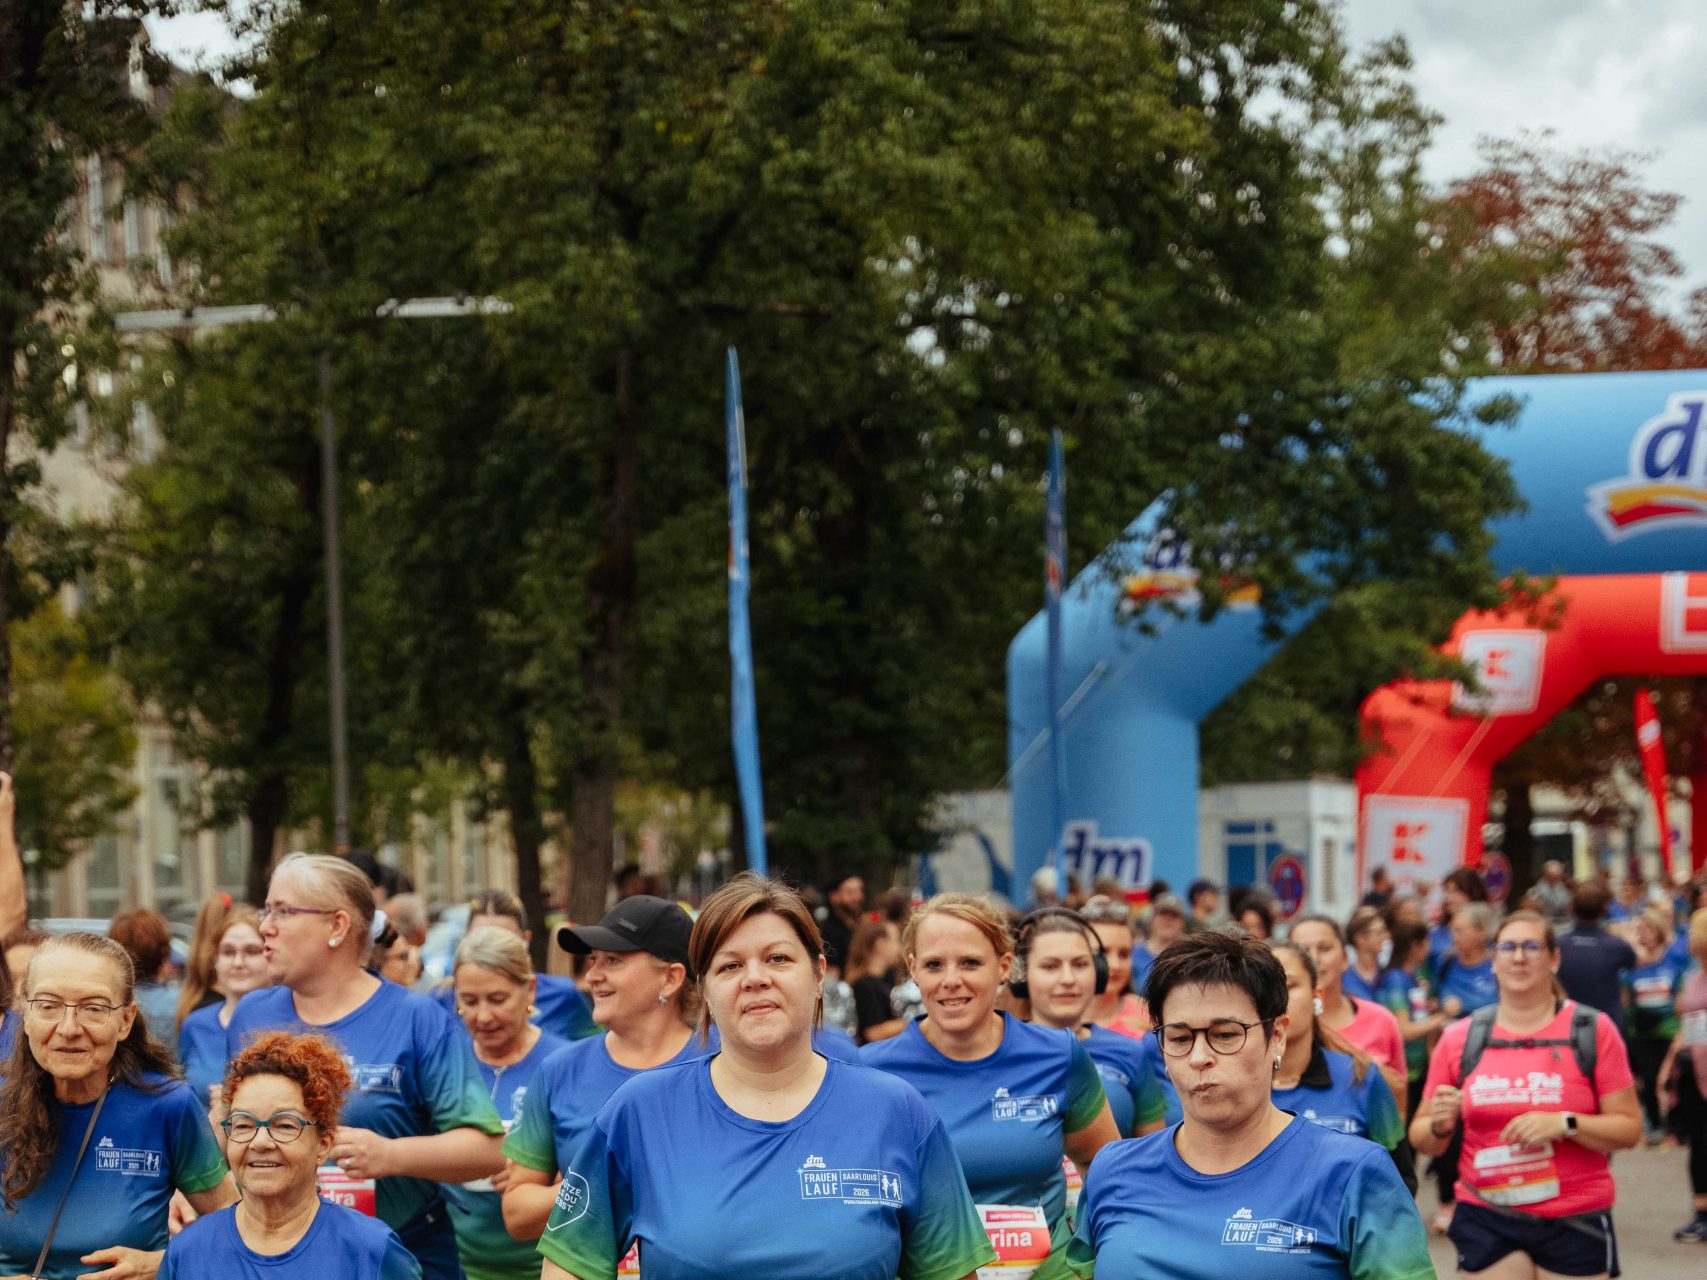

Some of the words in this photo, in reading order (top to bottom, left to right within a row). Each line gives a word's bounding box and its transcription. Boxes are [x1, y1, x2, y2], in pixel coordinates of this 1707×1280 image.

[1393, 822, 1429, 863] K
[98, 1150, 120, 1159] FRAUEN
[98, 1158, 120, 1168] LAUF
[804, 1172, 838, 1183] FRAUEN
[842, 1173, 878, 1181] SAARLOUIS
[805, 1182, 838, 1196] LAUF
[852, 1187, 870, 1197] 2026
[564, 1192, 577, 1204] DU
[1228, 1222, 1258, 1231] FRAUEN
[988, 1228, 1033, 1247] rina
[1225, 1231, 1256, 1242] LAUF
